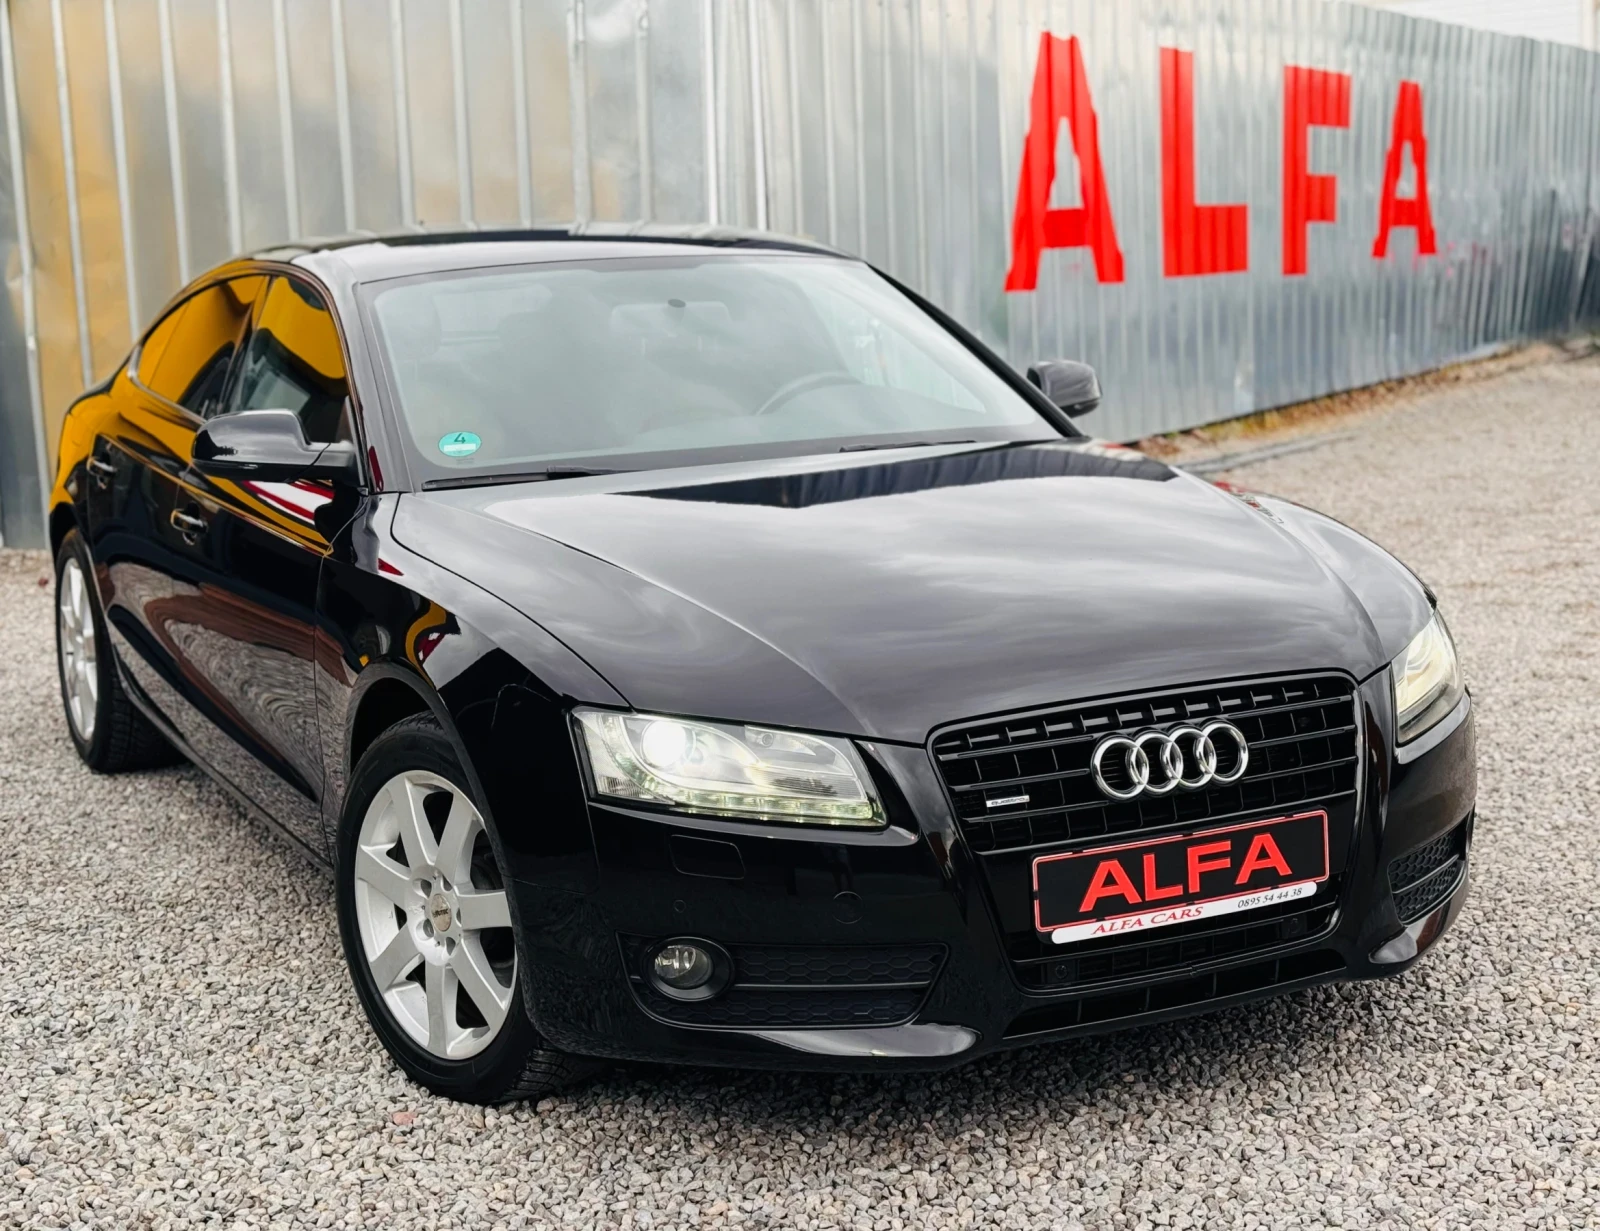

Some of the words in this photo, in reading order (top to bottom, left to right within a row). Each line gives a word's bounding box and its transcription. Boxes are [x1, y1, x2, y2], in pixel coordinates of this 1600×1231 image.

[1004, 30, 1437, 292] ALFA
[453, 432, 466, 444] 4
[1079, 832, 1292, 912] ALFA
[1237, 896, 1261, 908] 0895
[1262, 894, 1275, 904] 54
[1276, 890, 1289, 900] 44
[1290, 887, 1303, 897] 38
[1091, 917, 1145, 935] ALFA
[1150, 906, 1203, 924] CARS
